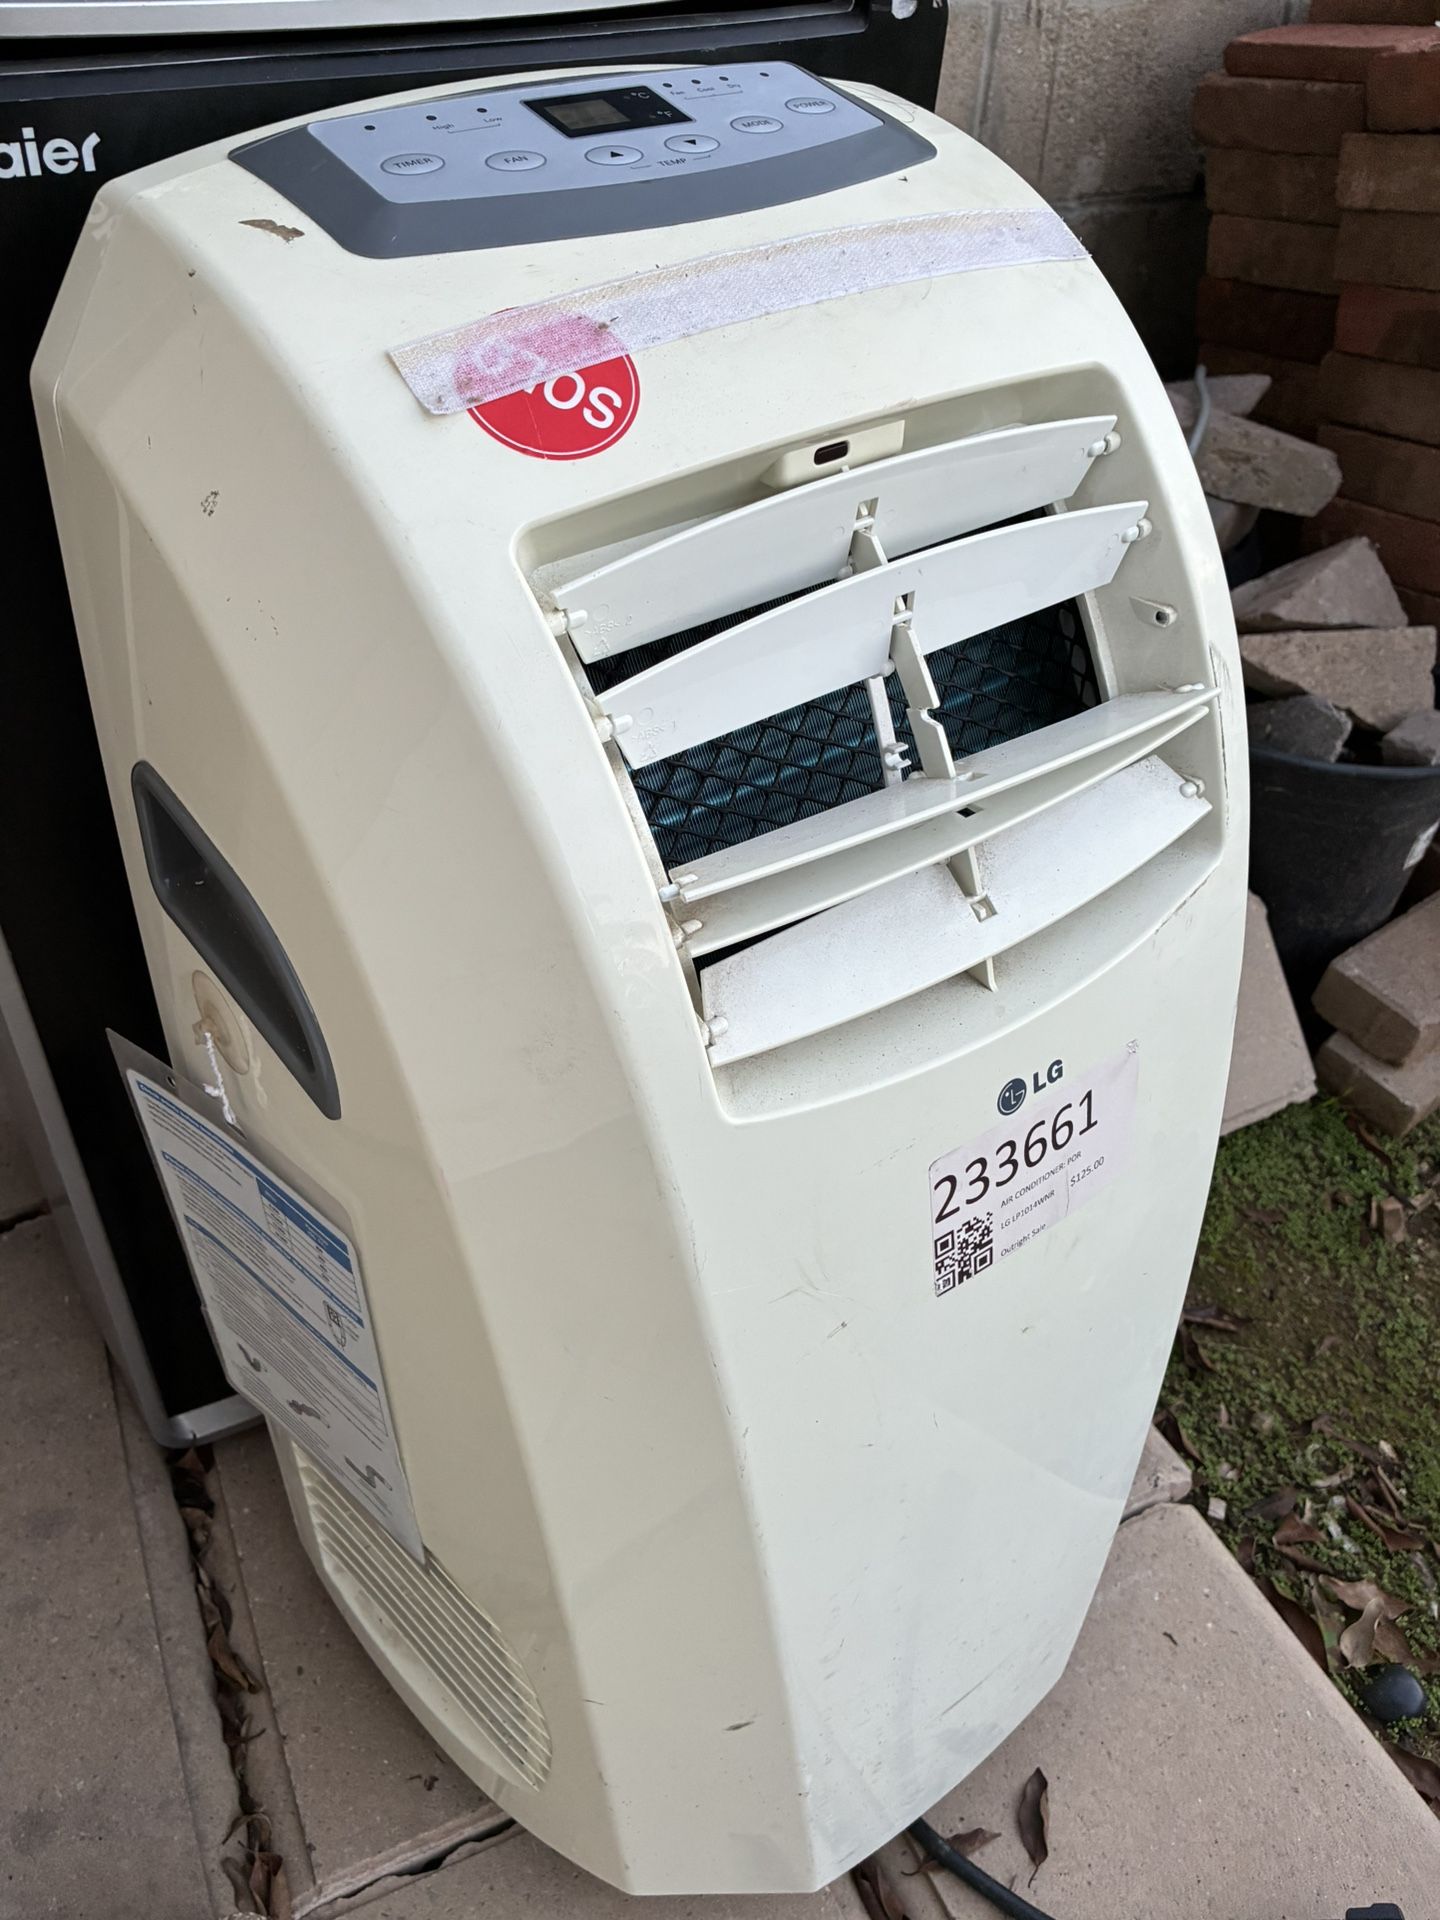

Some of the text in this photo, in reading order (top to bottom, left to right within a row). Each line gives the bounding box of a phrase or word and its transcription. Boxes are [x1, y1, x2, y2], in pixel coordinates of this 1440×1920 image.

[793, 100, 828, 109] POWER
[741, 119, 773, 128] MODE
[393, 157, 434, 169] TIMER
[503, 155, 529, 165] FAN
[655, 157, 687, 167] TEMP
[1032, 1059, 1064, 1094] LG
[934, 1088, 1098, 1225] 233661
[1070, 1156, 1105, 1188] $125.00
[1000, 1151, 1082, 1209] AIR CONDITIONER: POR
[1000, 1218, 1011, 1231] LG
[1000, 1223, 1047, 1257] Outright Sale
